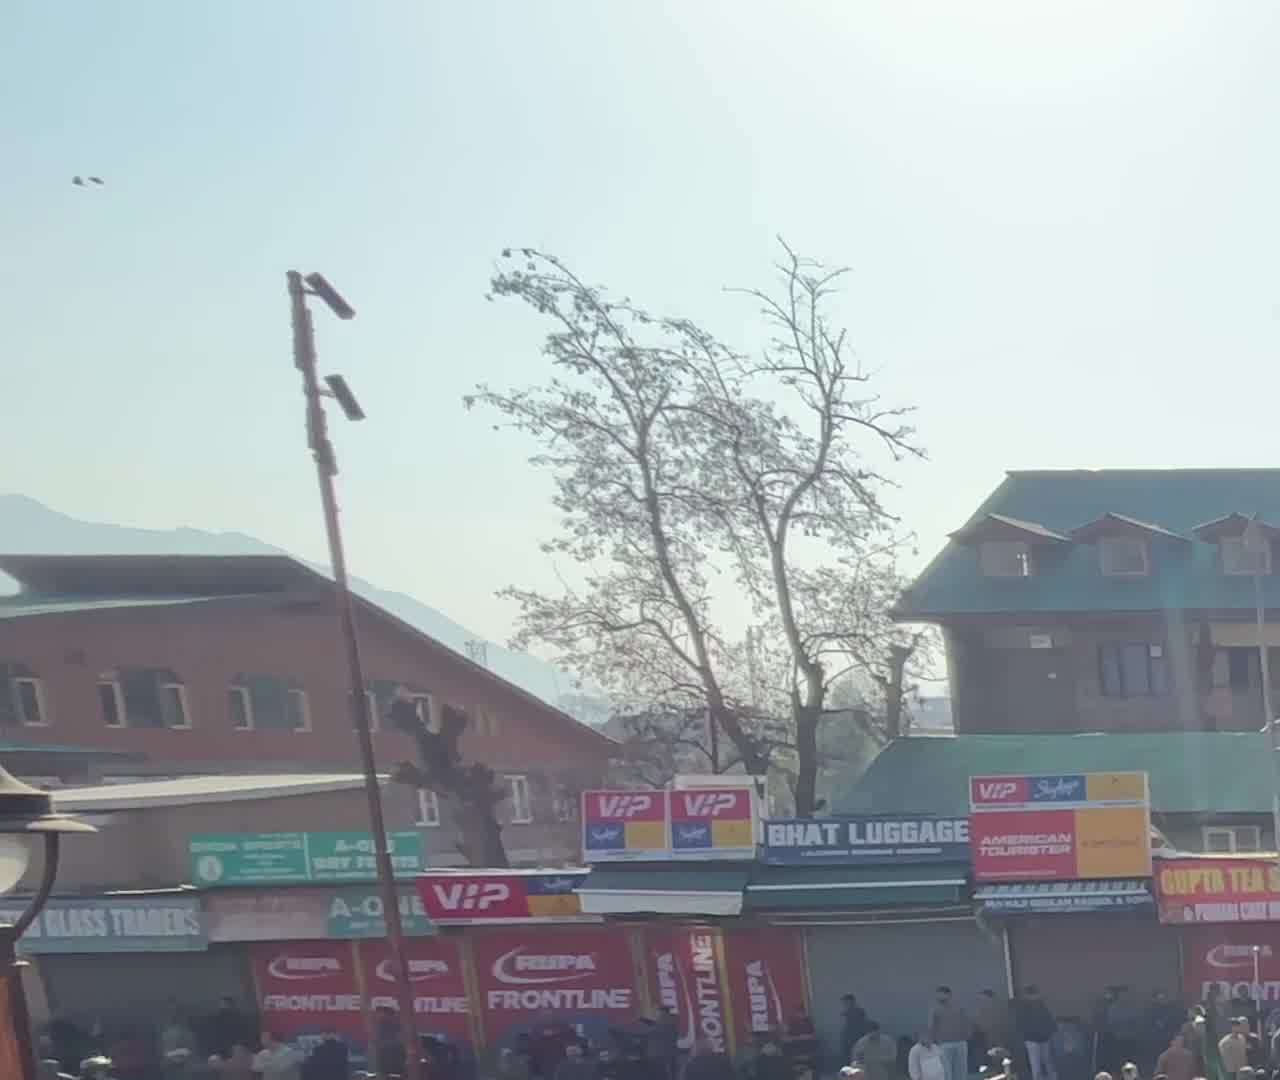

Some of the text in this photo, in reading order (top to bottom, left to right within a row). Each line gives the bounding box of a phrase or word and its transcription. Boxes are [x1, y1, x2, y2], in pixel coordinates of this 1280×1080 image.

[979, 782, 1017, 799] VIP
[599, 794, 653, 818] VIP
[683, 792, 737, 818] VIP
[767, 819, 969, 848] BHAT LUGGAGE
[980, 832, 1073, 845] AMERICAN
[979, 843, 1073, 857] TOURISTER
[431, 882, 511, 910] VIP
[487, 989, 633, 1010] FRONTLINE
[745, 959, 769, 1032] RUPA
